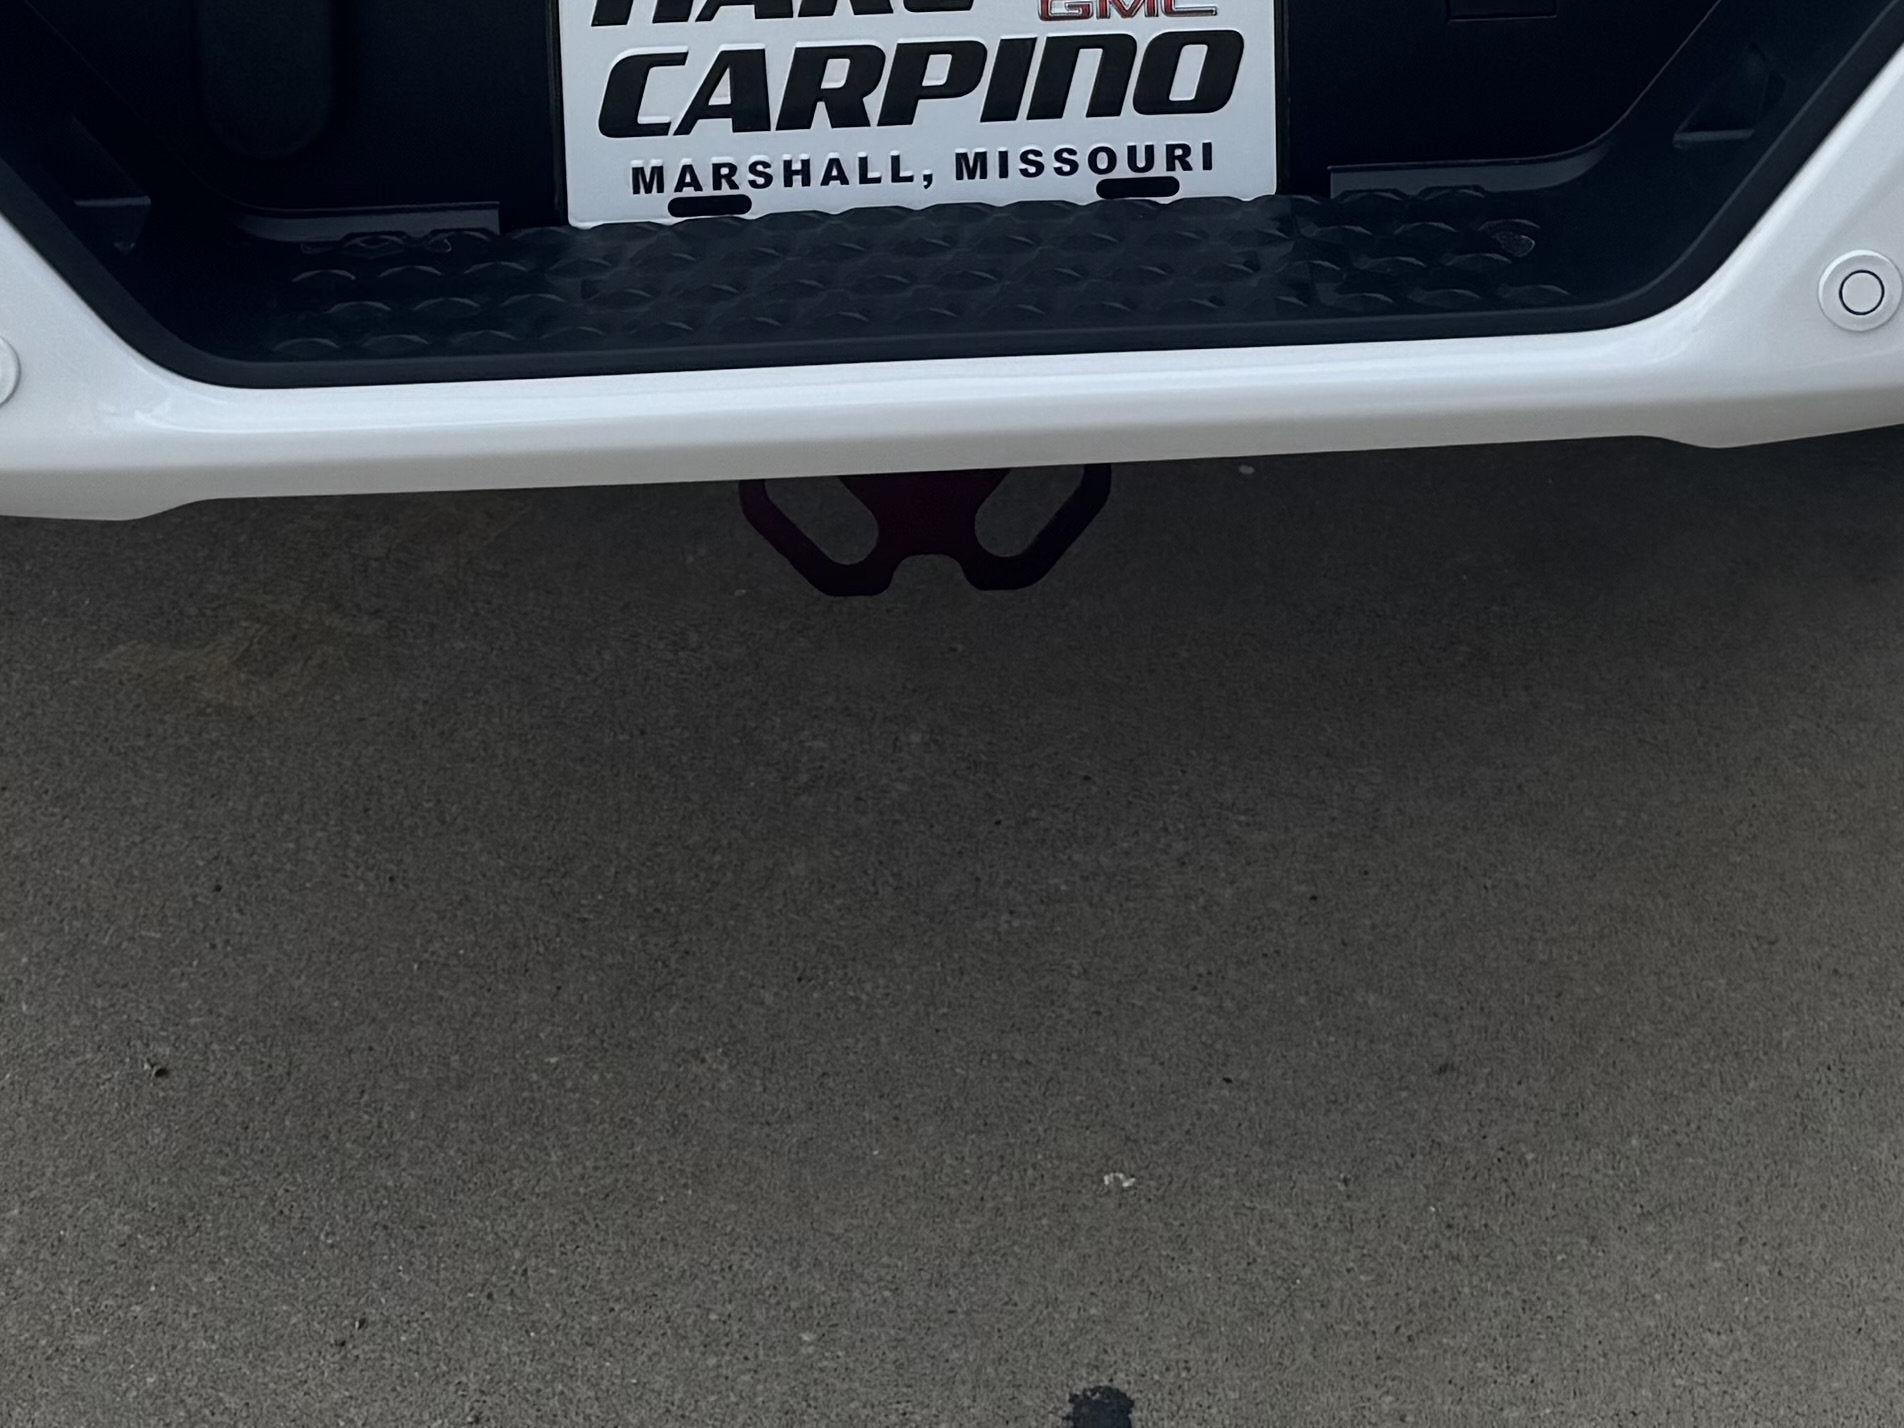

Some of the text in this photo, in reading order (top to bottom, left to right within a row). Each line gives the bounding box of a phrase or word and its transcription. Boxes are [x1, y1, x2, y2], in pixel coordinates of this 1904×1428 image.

[597, 29, 1245, 139] CARPINO
[630, 142, 1215, 196] MARSHALL, MISSOURI
